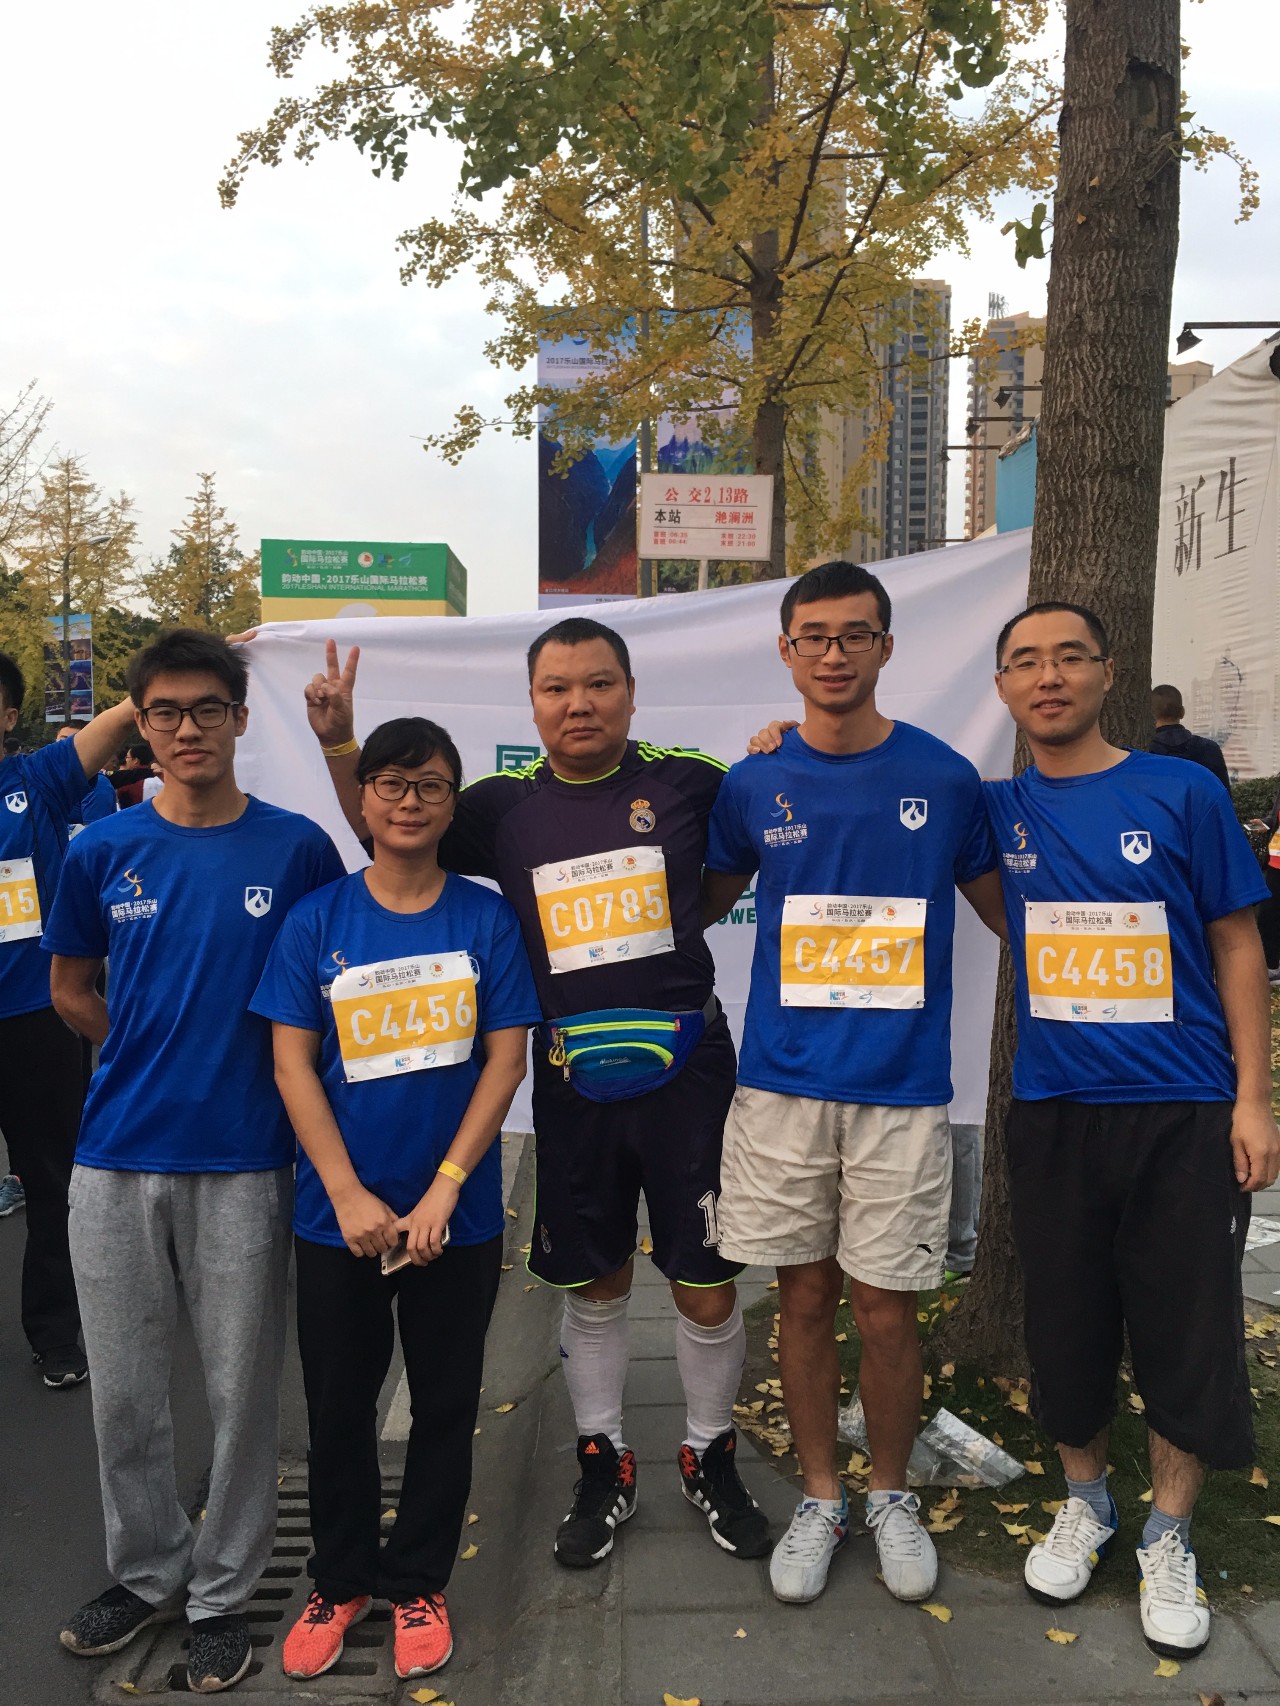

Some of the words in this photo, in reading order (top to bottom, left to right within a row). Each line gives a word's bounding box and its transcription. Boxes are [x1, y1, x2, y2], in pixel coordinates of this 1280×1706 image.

[654, 508, 682, 524] 本站
[328, 584, 386, 592] INTERNATIONAL
[763, 829, 808, 843] 国际马拉松赛
[571, 863, 613, 878] 国际马拉松赛
[1002, 858, 1037, 868] 际马拉松赛
[111, 904, 158, 919] 国际马拉松赛
[550, 883, 664, 938] C0785
[826, 909, 872, 917] 国际马拉松赛
[1065, 916, 1113, 925] 国际马拉松赛
[794, 936, 917, 974] C4457
[1037, 946, 1165, 987] C4458
[375, 969, 422, 984] 国际马拉松赛
[351, 990, 472, 1046] C4456
